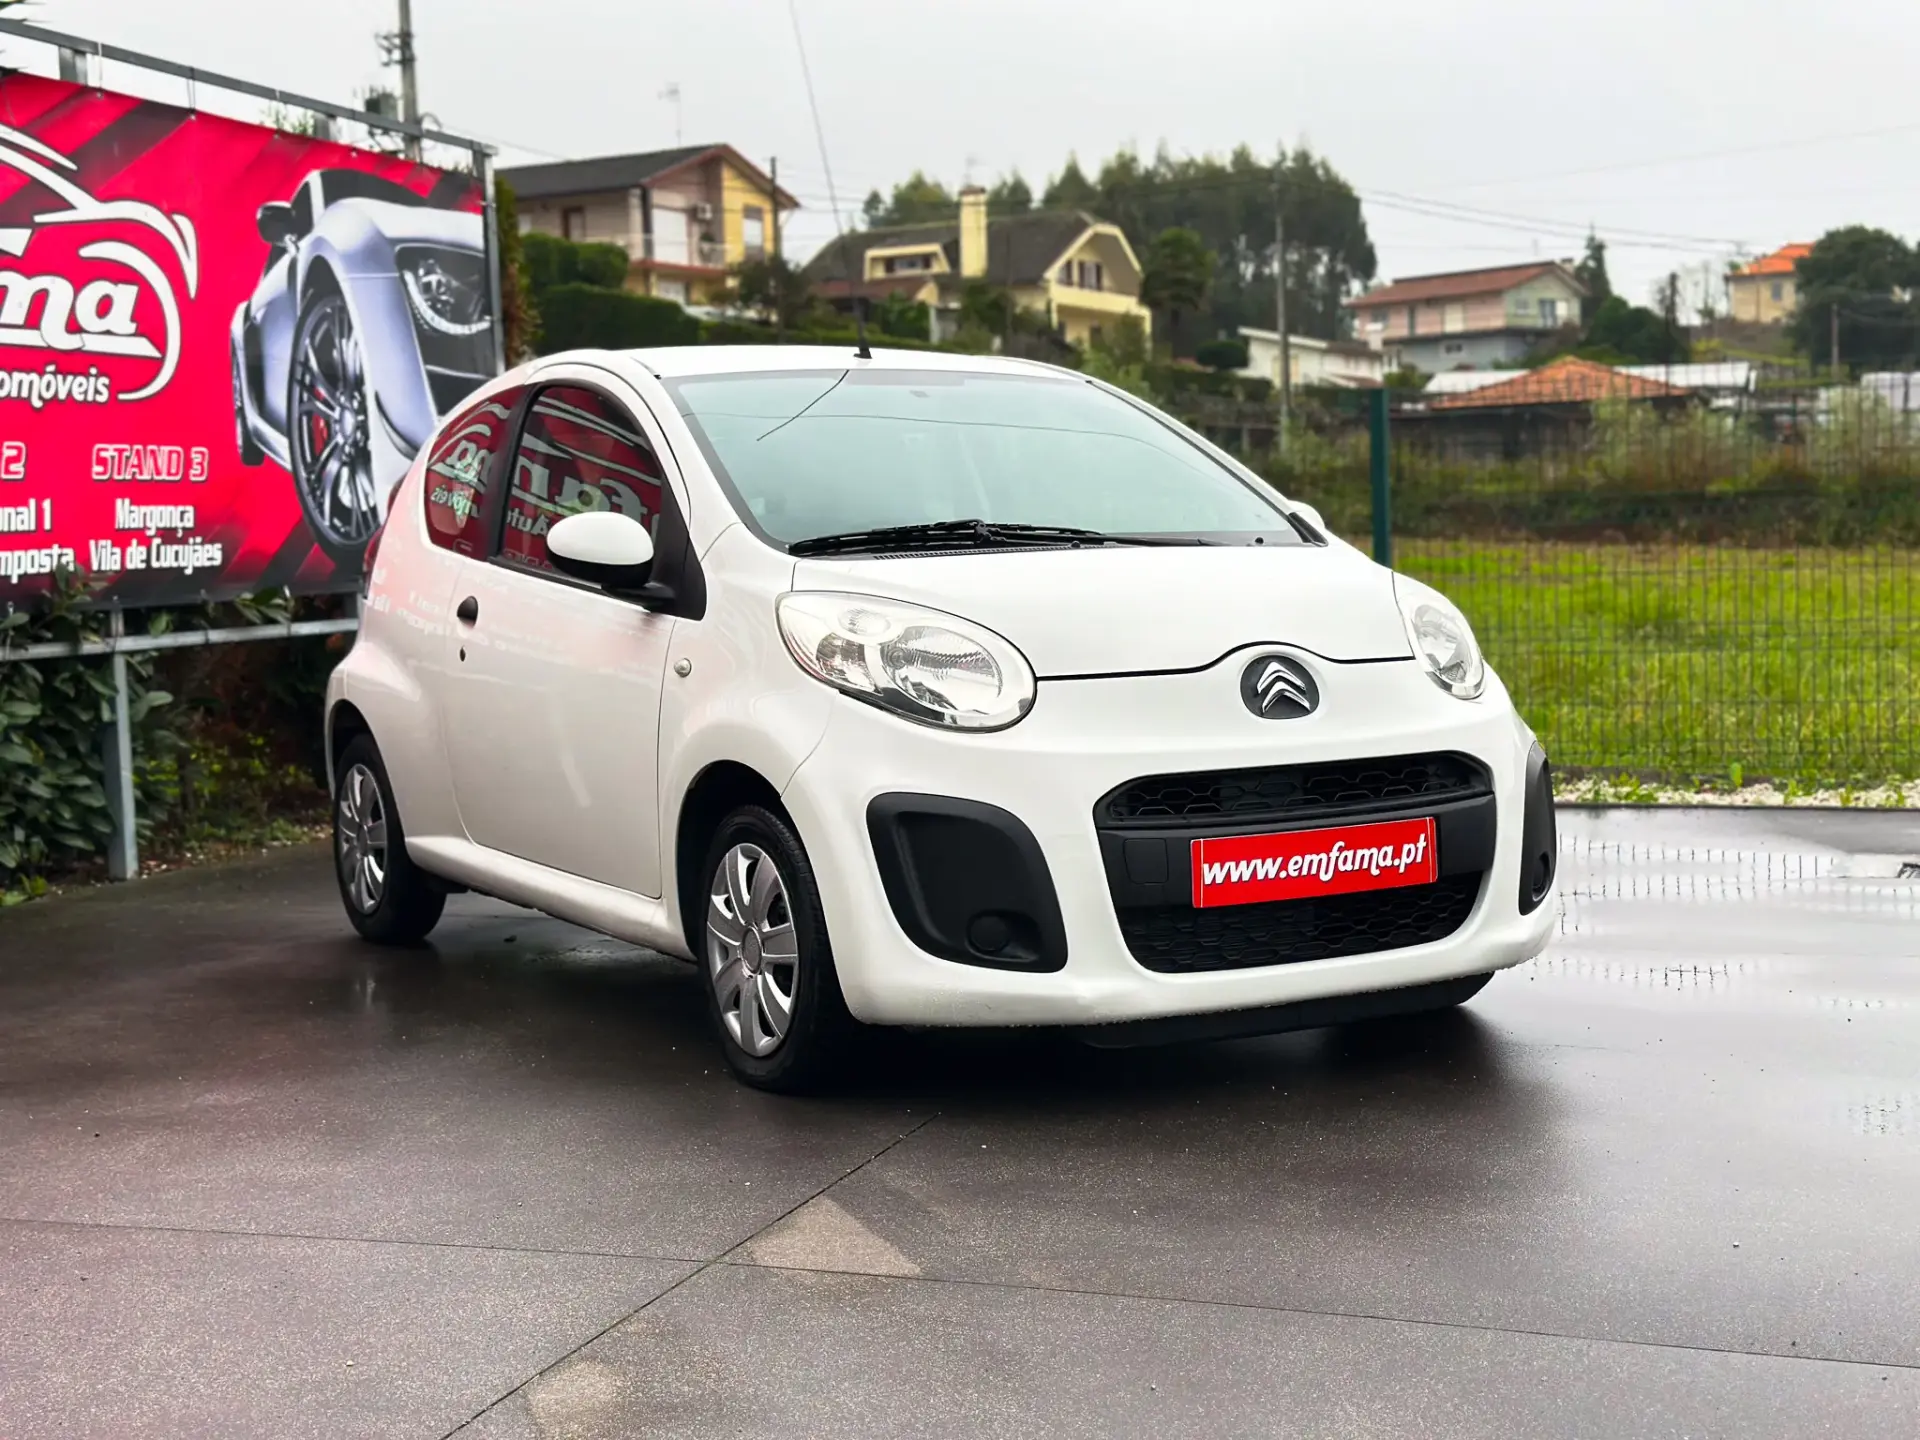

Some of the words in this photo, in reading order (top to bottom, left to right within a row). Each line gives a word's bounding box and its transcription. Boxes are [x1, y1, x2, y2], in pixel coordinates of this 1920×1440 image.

[0, 441, 26, 479] 2
[92, 444, 184, 480] STAND
[189, 447, 209, 481] 3
[0, 498, 36, 532] nal
[42, 498, 52, 531] 1
[115, 497, 194, 538] Margonça
[89, 539, 121, 571] Vila
[126, 538, 147, 569] de
[151, 536, 223, 575] Cucujães
[1202, 833, 1427, 885] www.emfama.pt
